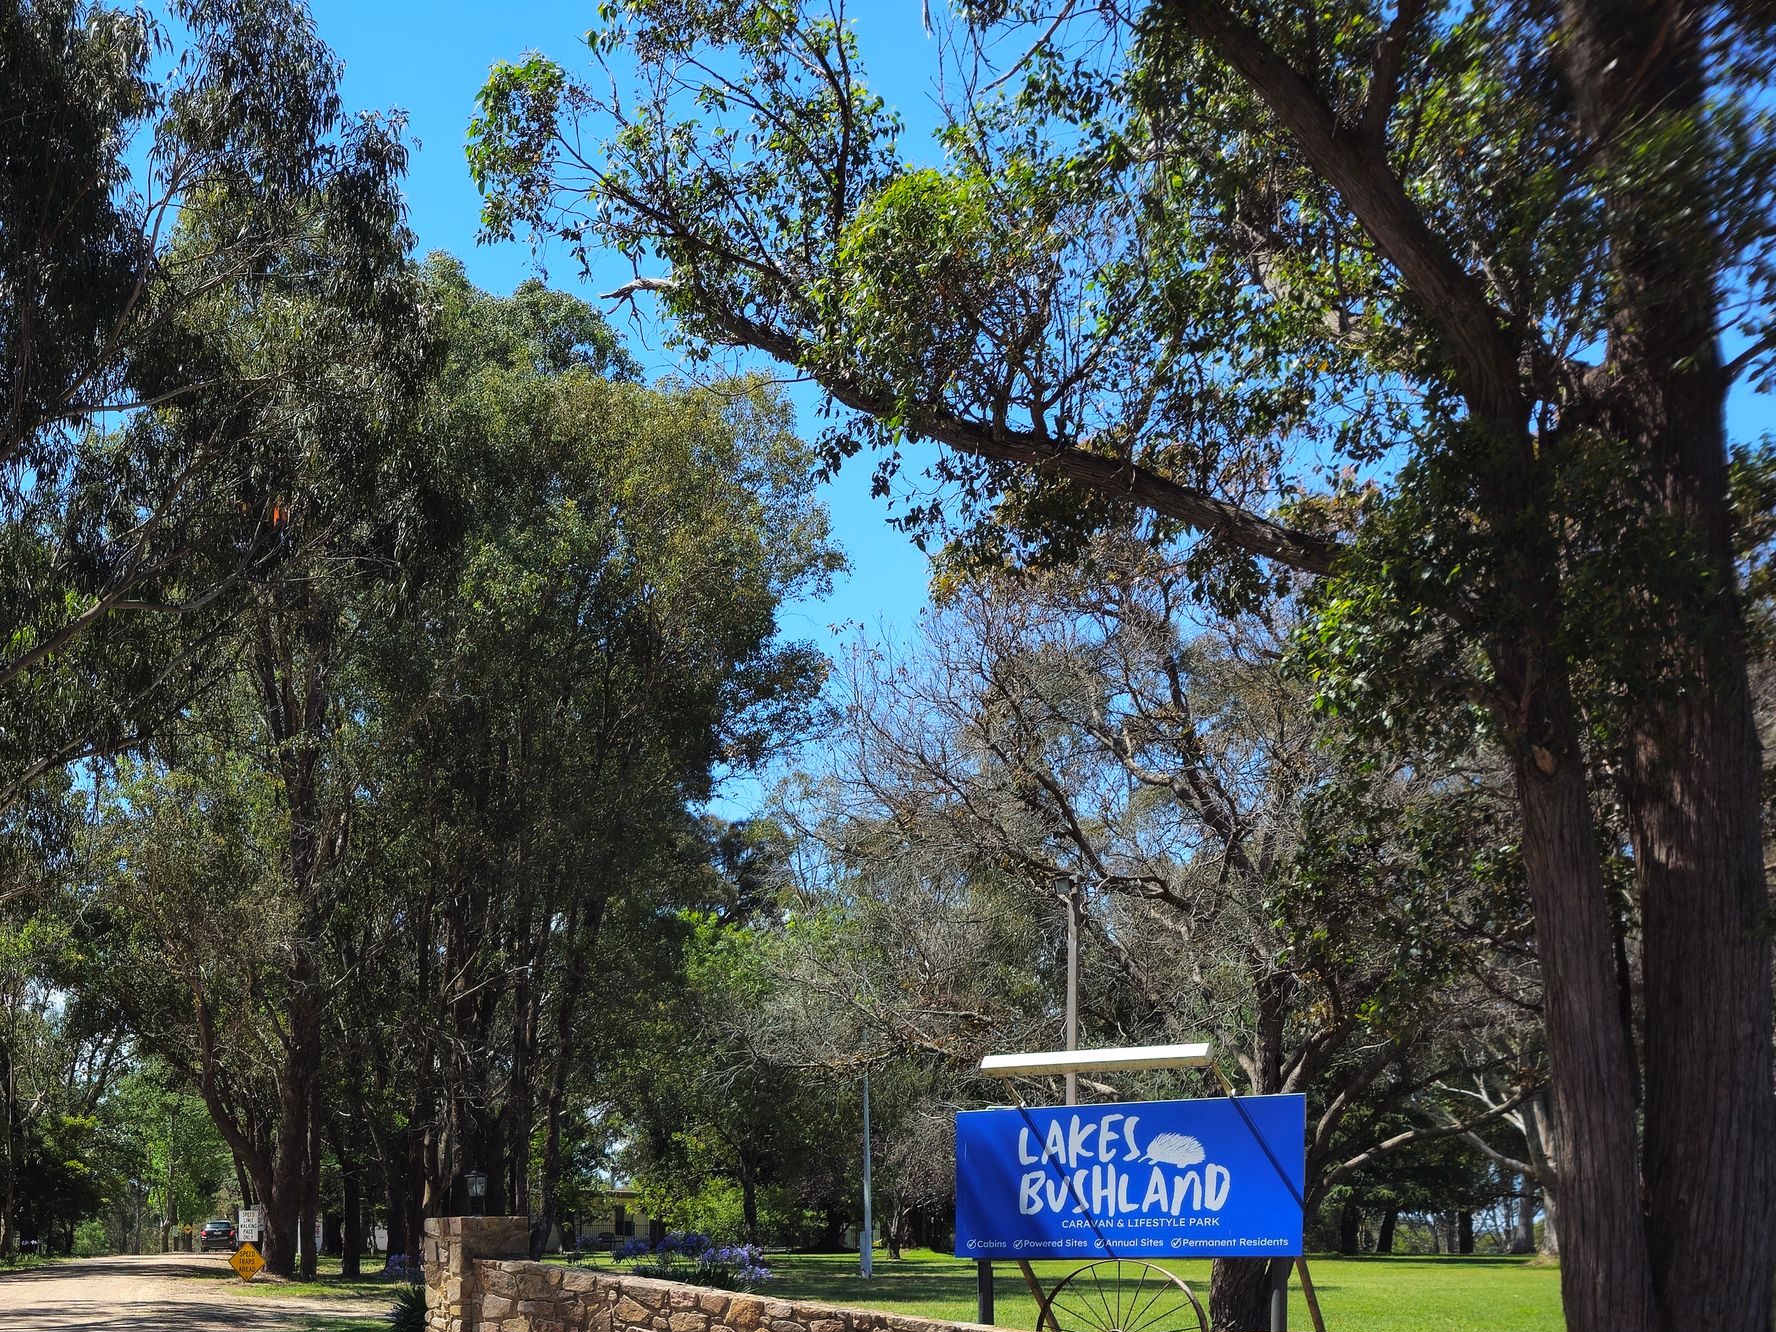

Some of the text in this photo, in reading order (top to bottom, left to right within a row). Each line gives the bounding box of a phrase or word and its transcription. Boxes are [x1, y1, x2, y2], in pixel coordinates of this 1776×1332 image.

[1018, 1113, 1140, 1168] LAKES
[1019, 1163, 1231, 1217] BUSHLAND
[1062, 1217, 1220, 1228] CARAVAN & LIFESTYLE PARK
[977, 1237, 1289, 1248] Cabins Powered Sites Annual Sites Permanent Residents
